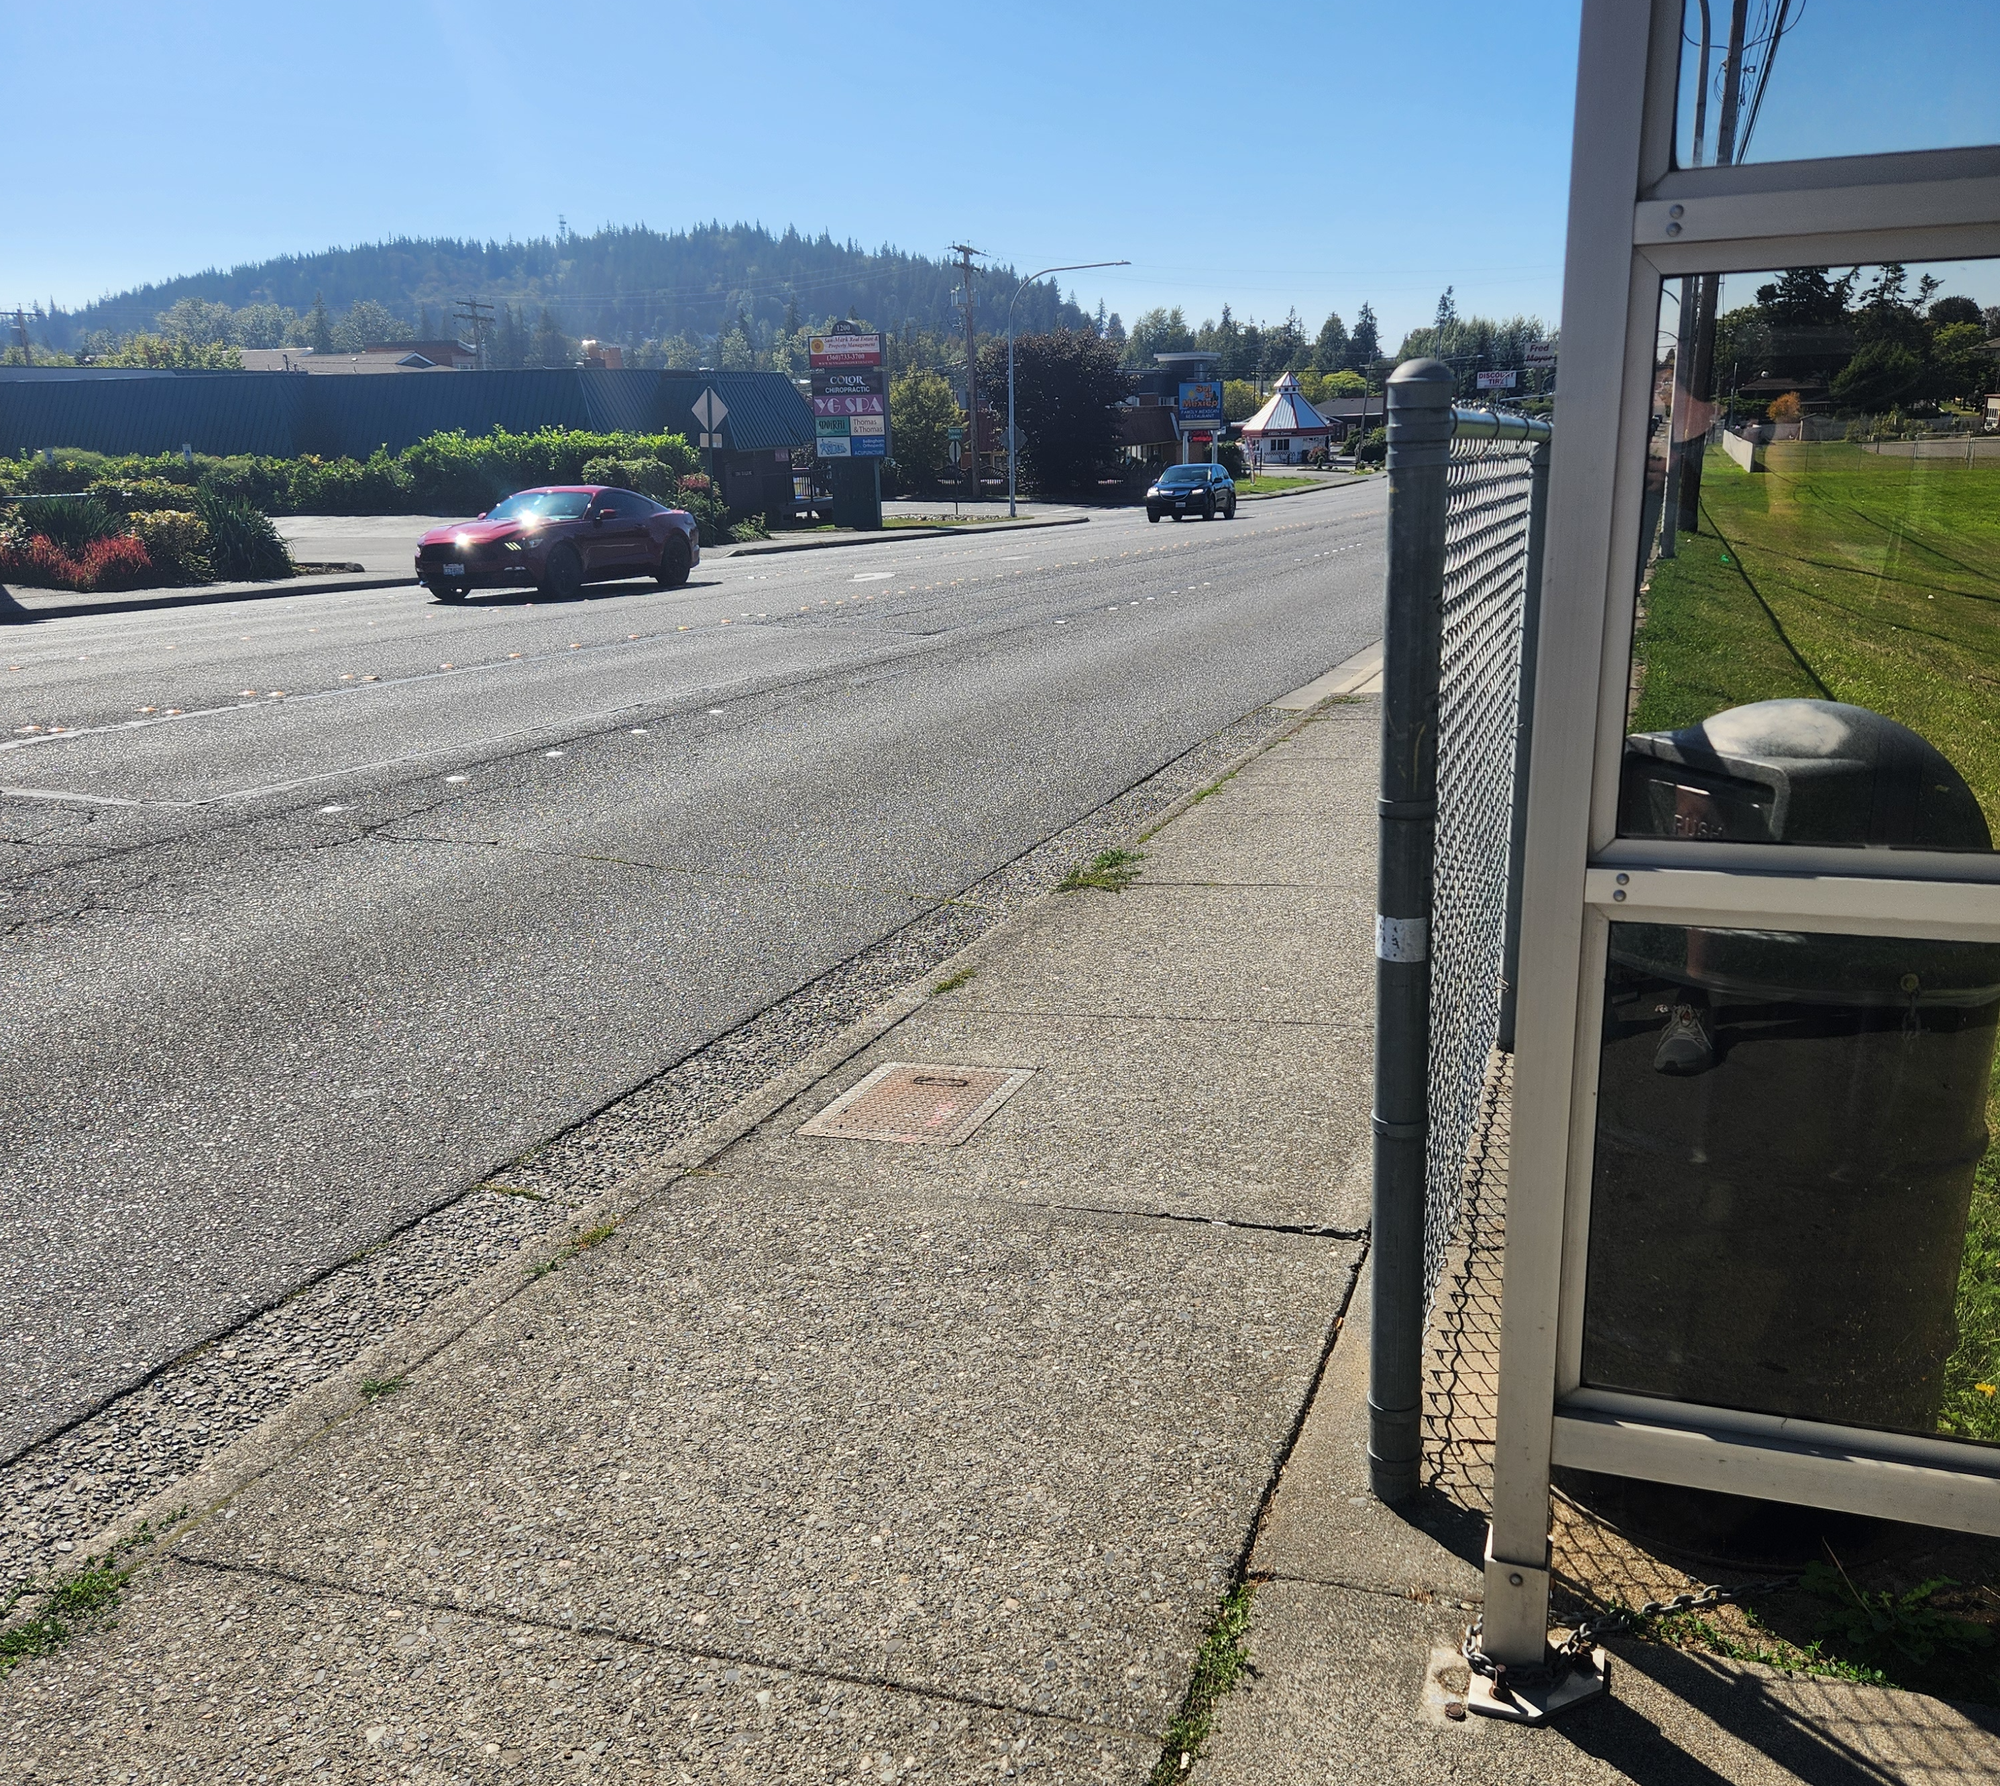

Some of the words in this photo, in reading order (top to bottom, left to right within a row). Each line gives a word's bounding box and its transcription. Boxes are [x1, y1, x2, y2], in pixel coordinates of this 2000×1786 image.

[1530, 344, 1549, 352] Fred
[1478, 372, 1514, 380] DISCOUNT
[830, 375, 866, 386] COLOR
[825, 386, 870, 394] CHIROPRACTIC
[1196, 384, 1212, 393] Sol
[814, 398, 840, 413] YG
[844, 397, 883, 413] SPA
